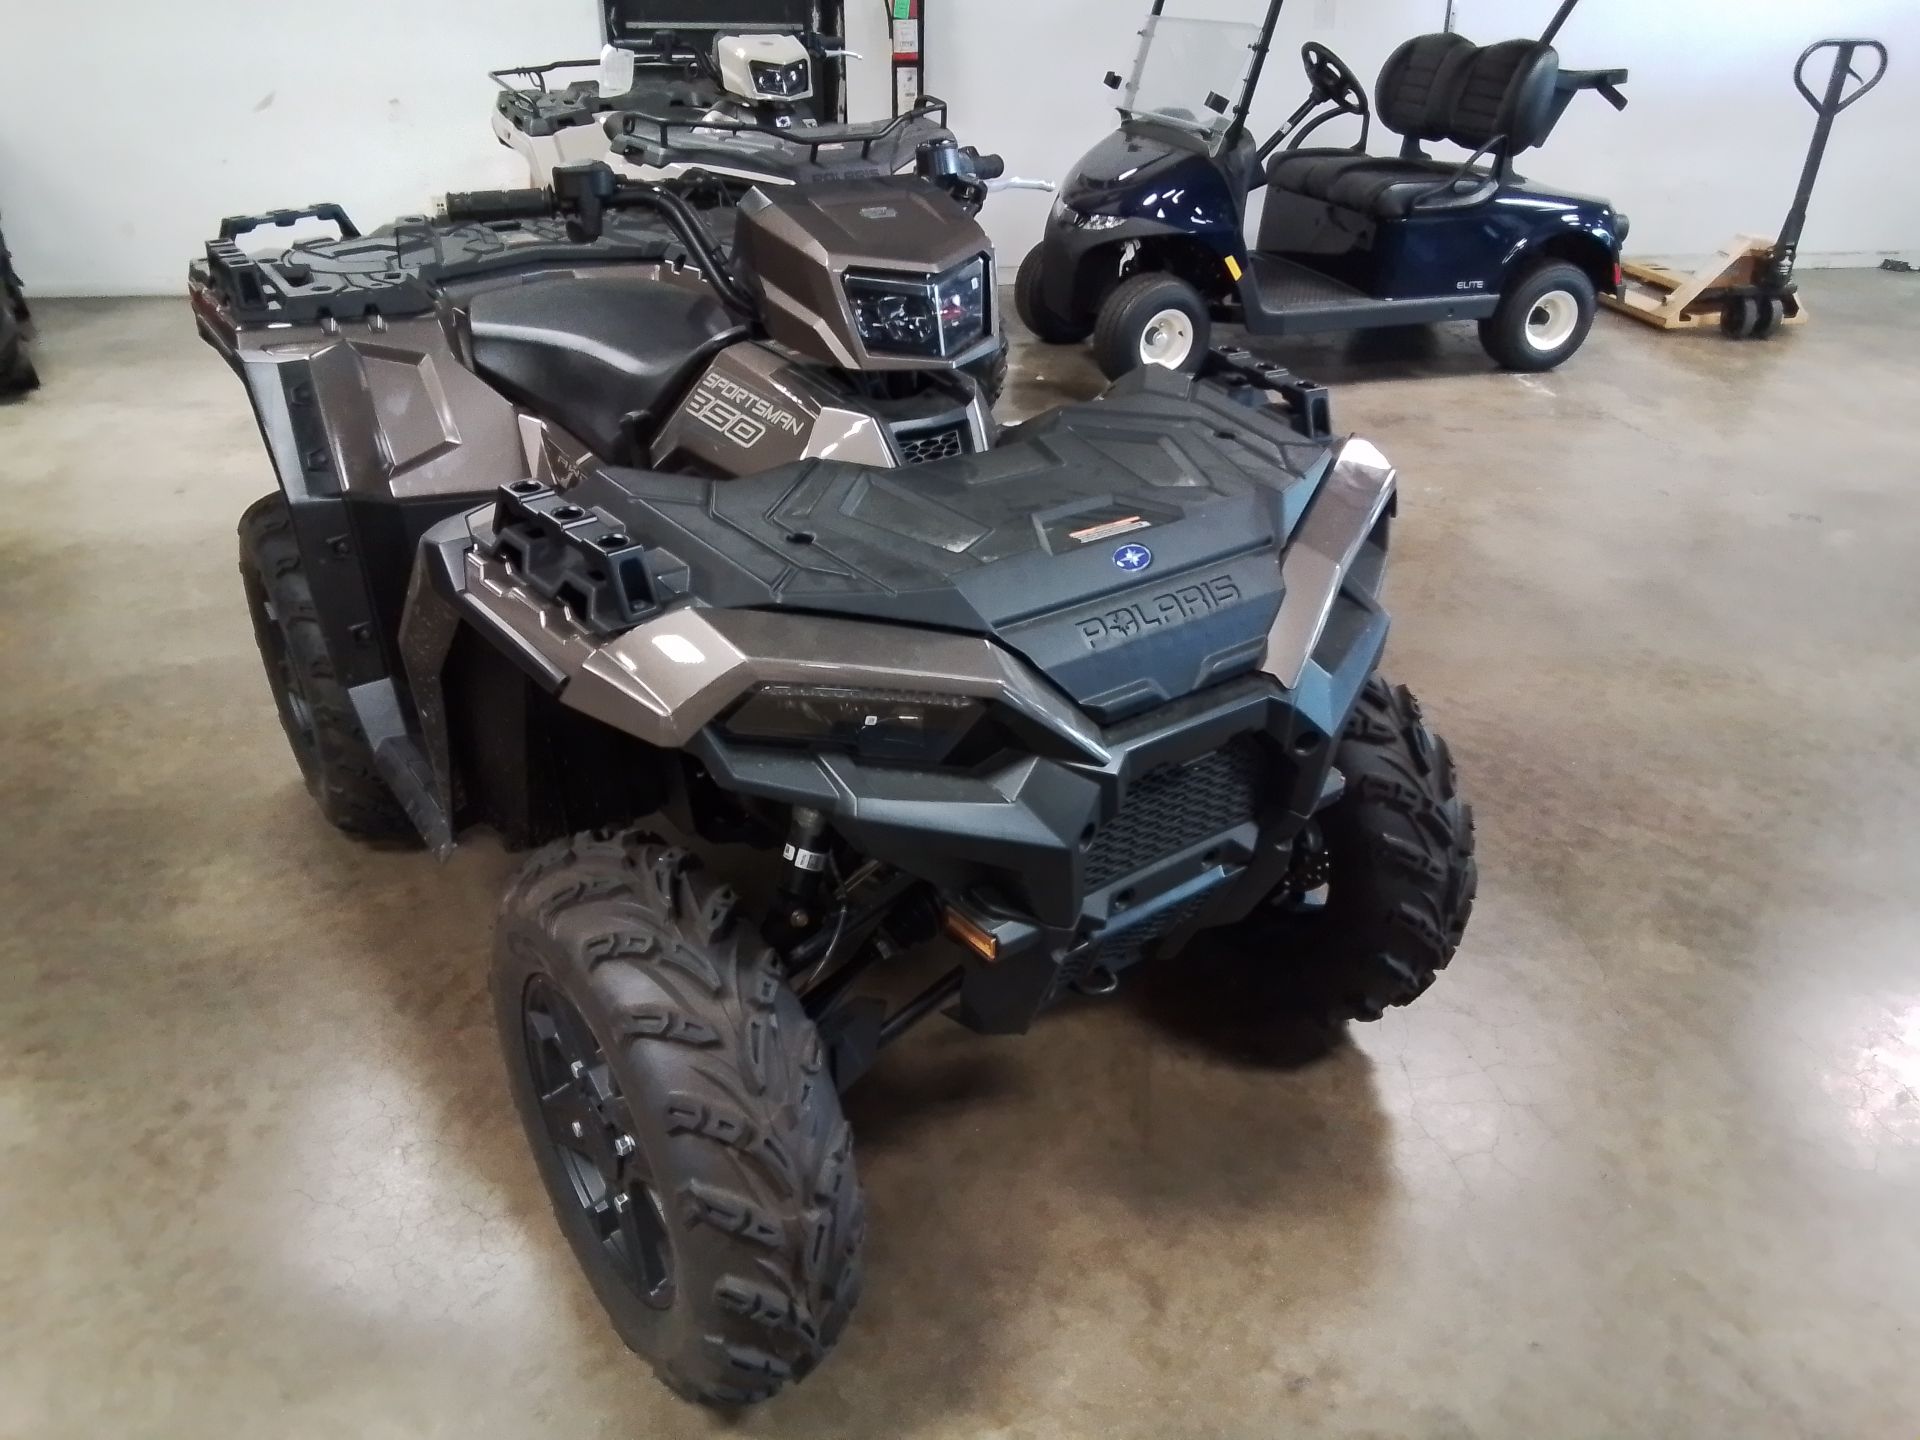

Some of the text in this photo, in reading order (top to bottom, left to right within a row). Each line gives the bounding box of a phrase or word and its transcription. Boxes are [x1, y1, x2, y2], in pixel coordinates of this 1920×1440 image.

[1456, 280, 1484, 289] ELITE
[702, 372, 805, 436] SPORTSMAN
[1074, 574, 1241, 649] POLARIS
